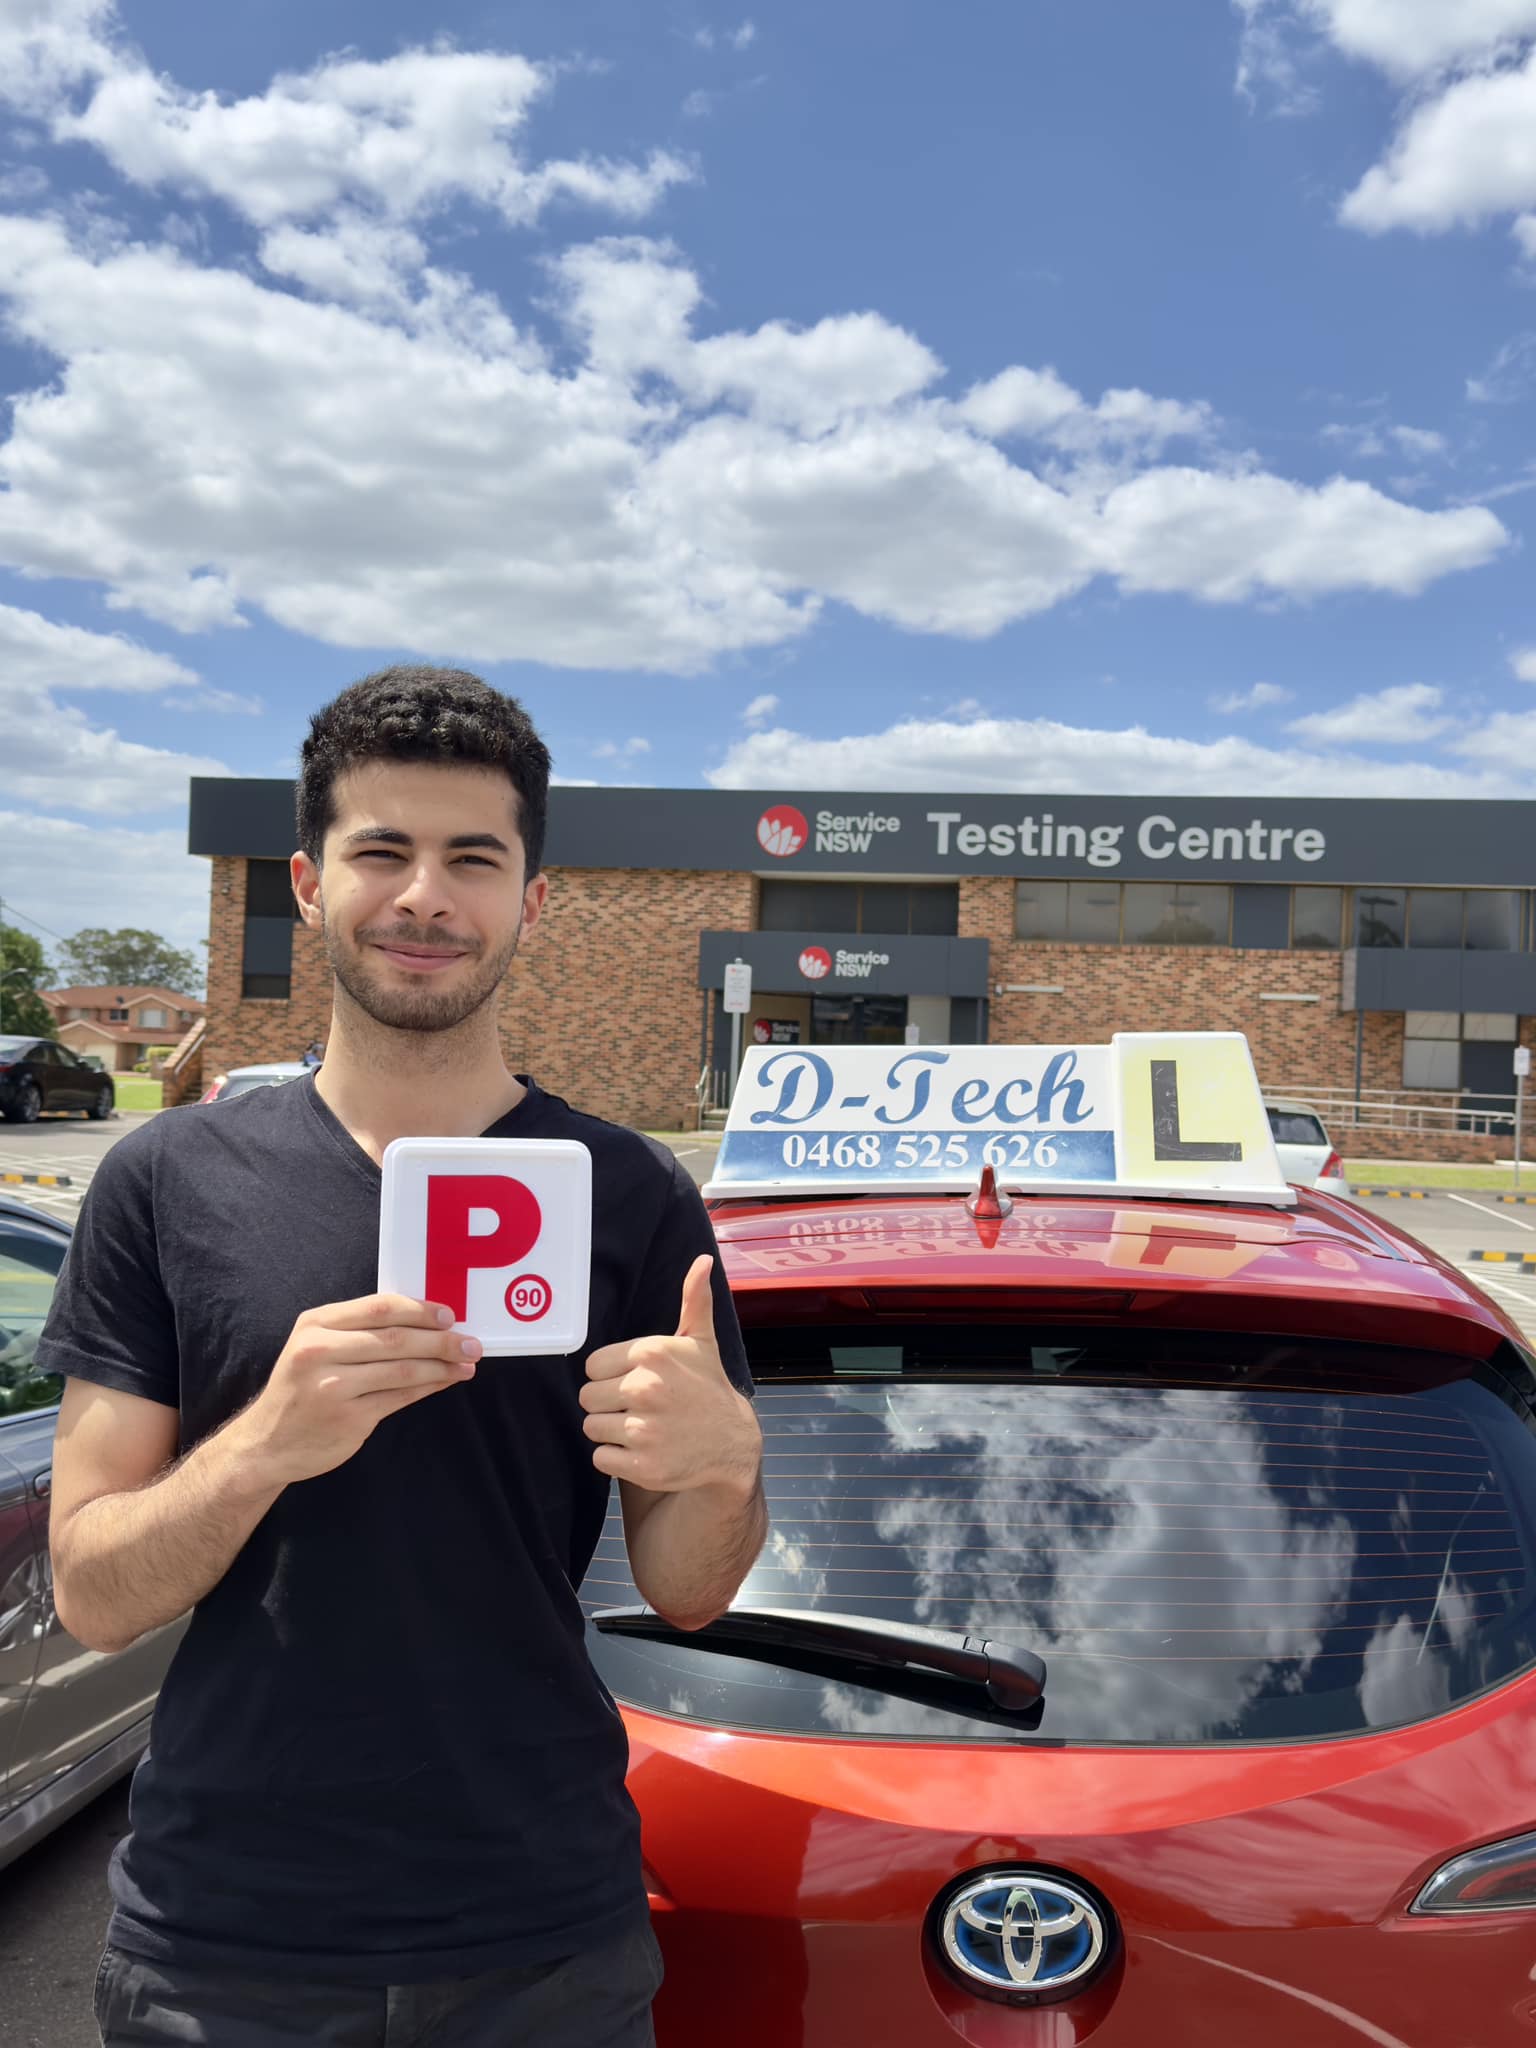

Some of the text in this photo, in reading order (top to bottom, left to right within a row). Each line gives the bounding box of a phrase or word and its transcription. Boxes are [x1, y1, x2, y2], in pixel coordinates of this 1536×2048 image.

[816, 811, 901, 833] Service
[816, 831, 872, 853] NSW
[927, 812, 1326, 867] Testing Centre
[835, 949, 890, 965] Service
[835, 963, 872, 977] NSW
[750, 1050, 1095, 1124] D-Tech
[1150, 1059, 1243, 1162] L
[782, 1134, 1059, 1168] 0468 525 626
[425, 1174, 542, 1323] P
[515, 1288, 542, 1308] 90
